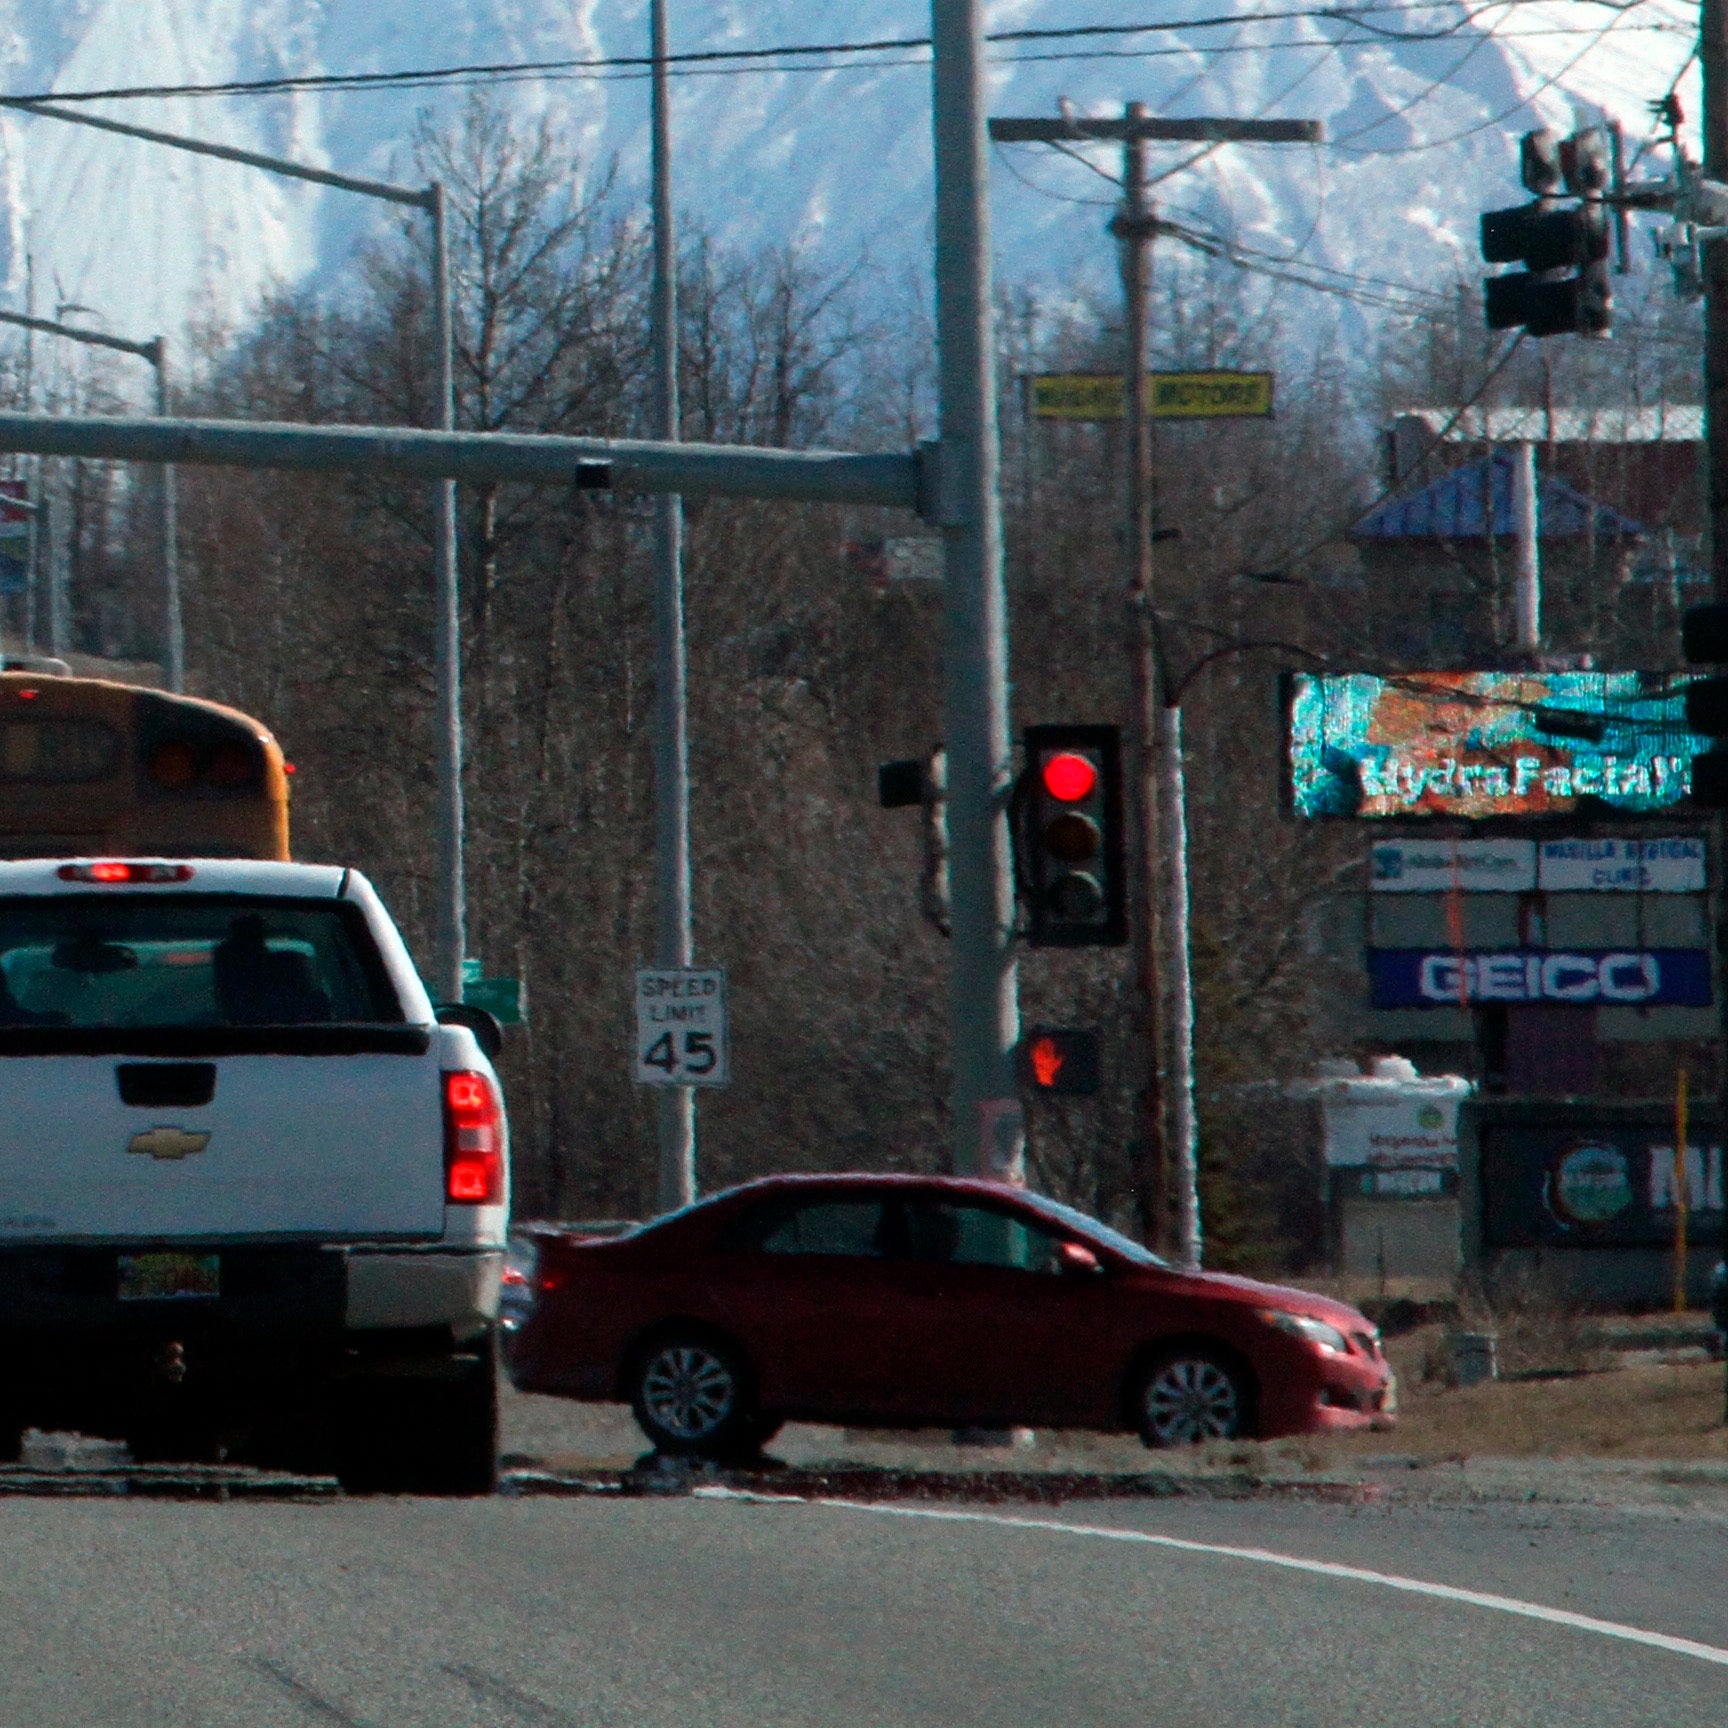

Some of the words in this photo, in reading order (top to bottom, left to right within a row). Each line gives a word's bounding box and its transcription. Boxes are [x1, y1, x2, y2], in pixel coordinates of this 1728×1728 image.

[644, 977, 717, 997] SPEED
[1421, 953, 1660, 1001] GEICO
[650, 1004, 706, 1023] LIMIT
[644, 1030, 717, 1074] 45
